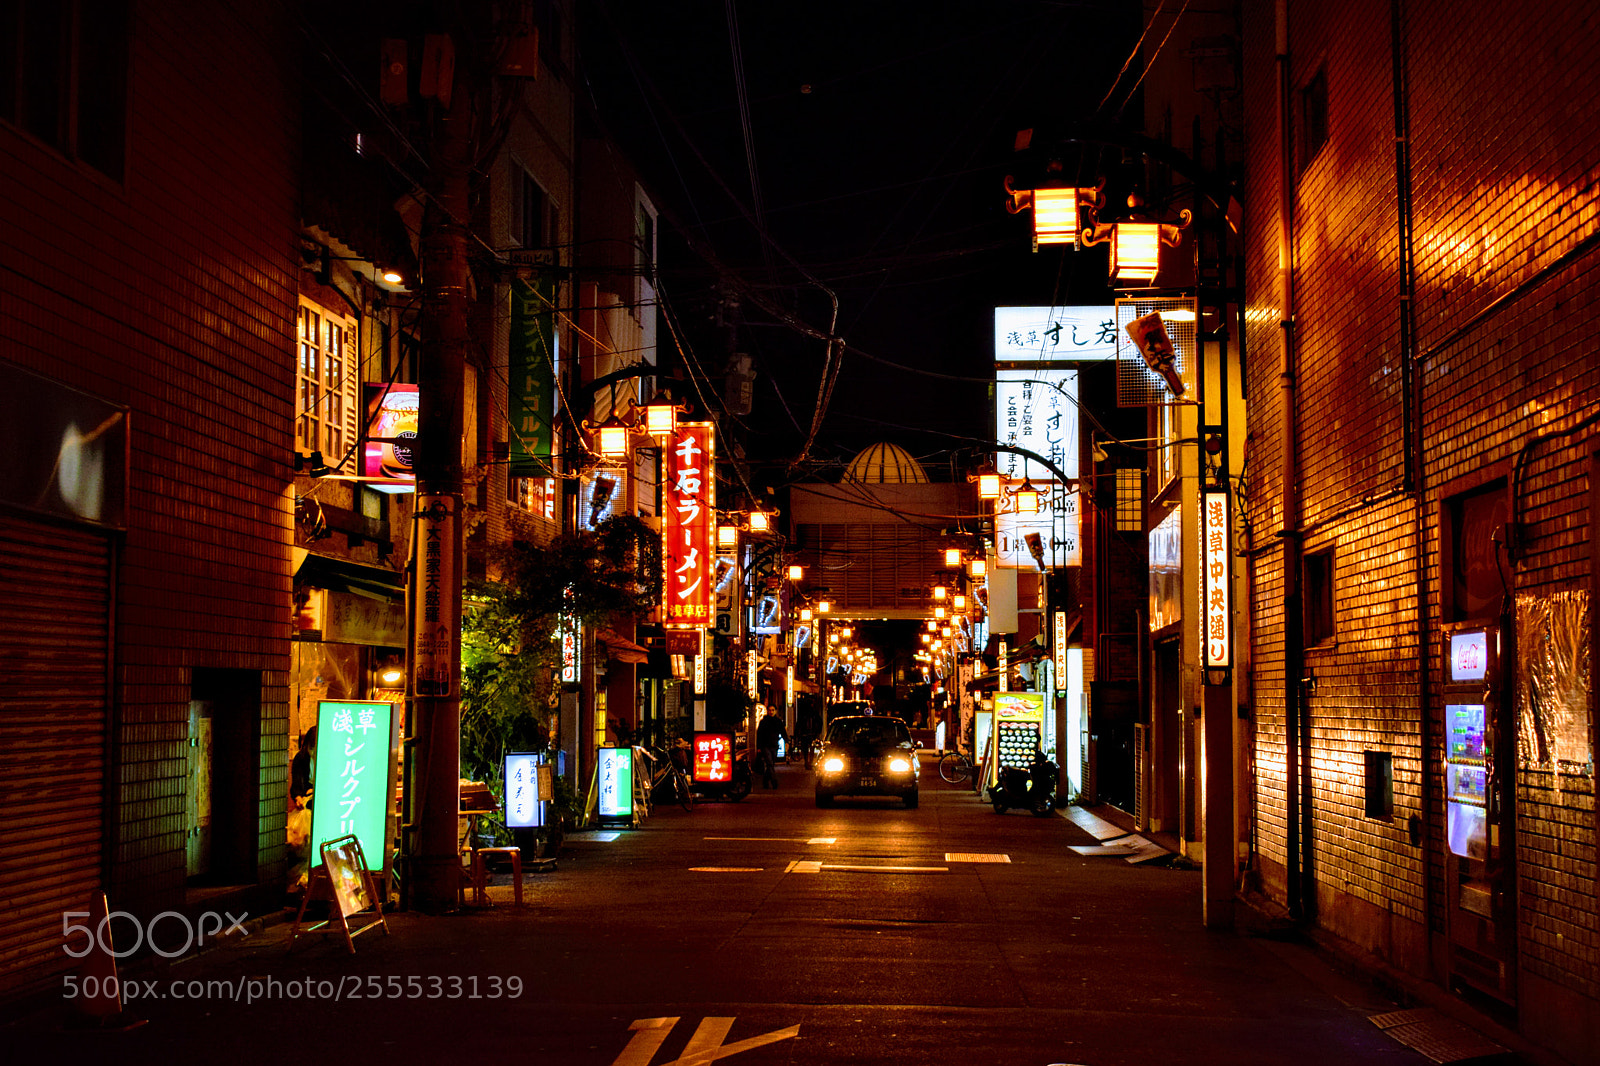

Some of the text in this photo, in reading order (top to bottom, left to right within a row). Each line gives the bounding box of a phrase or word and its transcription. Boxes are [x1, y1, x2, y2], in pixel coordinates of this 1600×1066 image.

[673, 436, 702, 600] 千石ラーメン
[669, 603, 708, 618] 浅草店
[1208, 501, 1225, 661] 浅草中央通り
[340, 737, 366, 848] シルクプリ
[709, 737, 724, 780] らーめん
